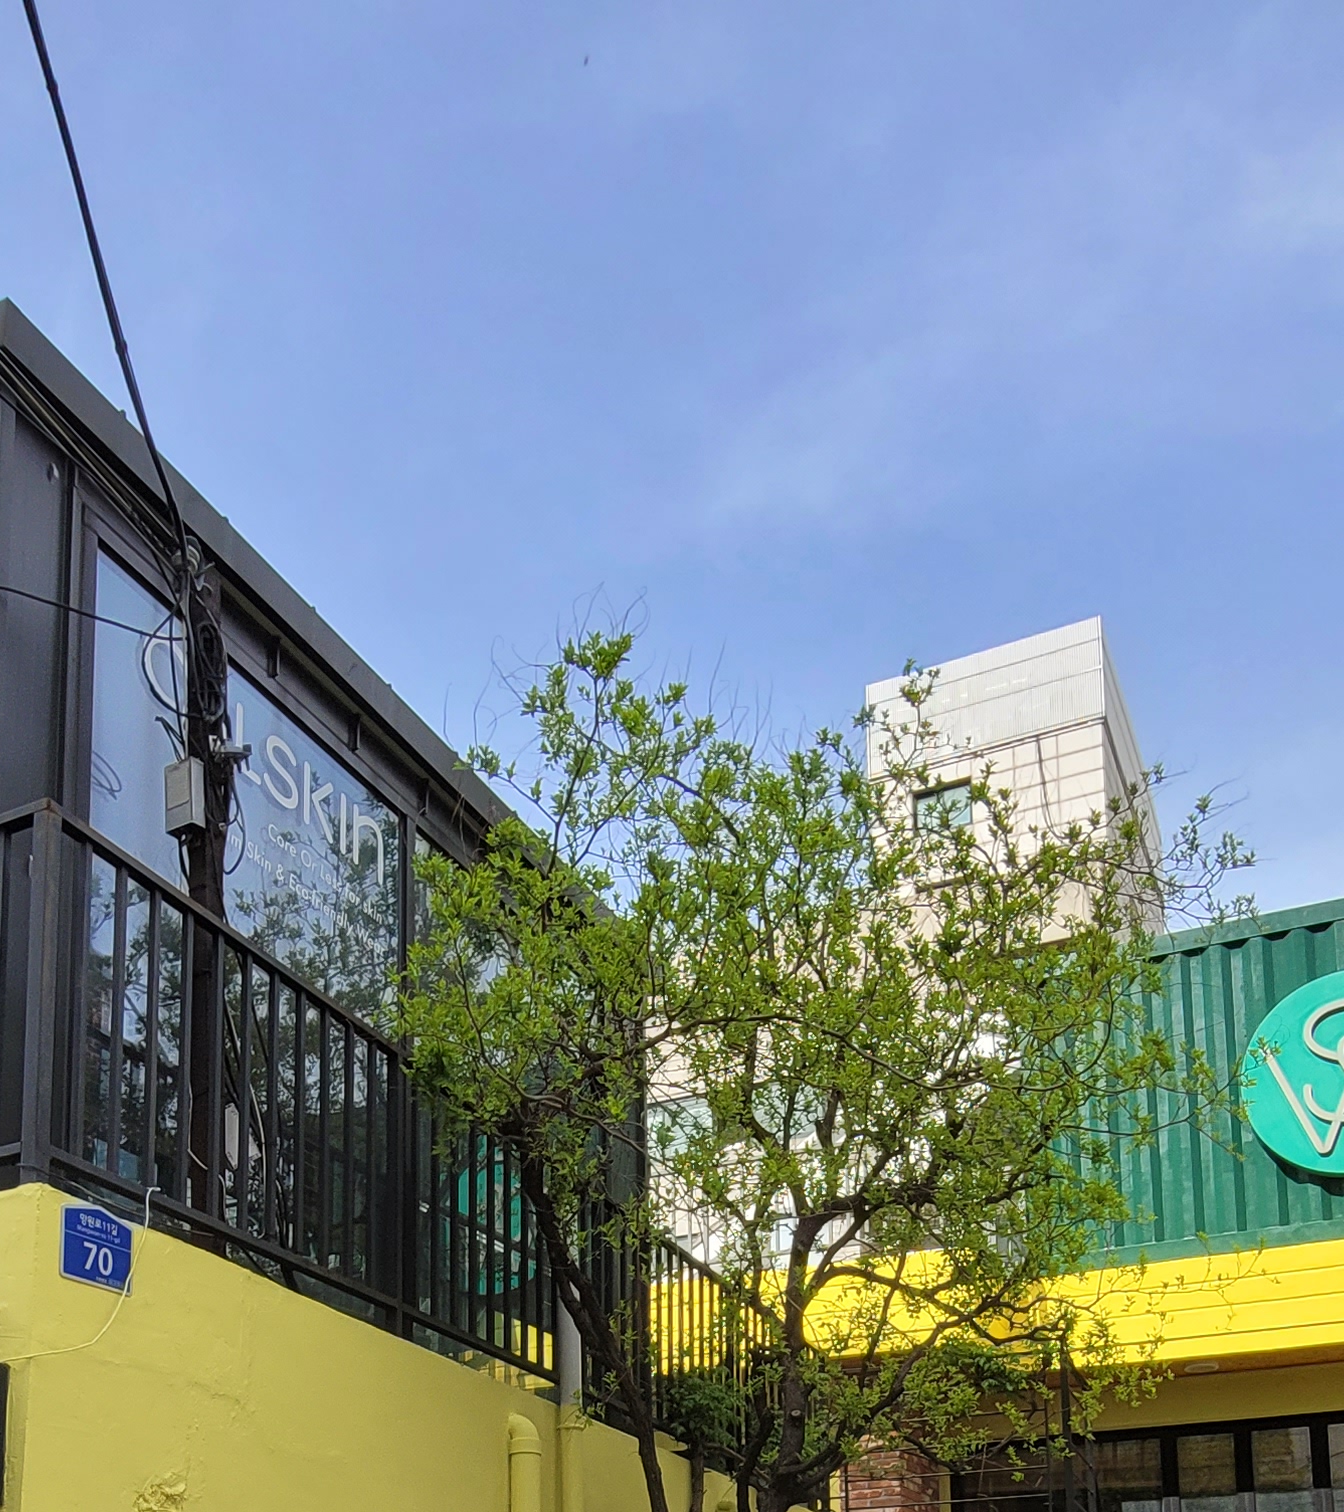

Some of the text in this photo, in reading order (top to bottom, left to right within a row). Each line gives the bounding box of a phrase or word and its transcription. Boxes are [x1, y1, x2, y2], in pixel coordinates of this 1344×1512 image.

[246, 841, 272, 873] Skin
[275, 864, 286, 882] &
[268, 823, 296, 857] Core
[363, 900, 382, 925] skin
[83, 1241, 113, 1276] 70
